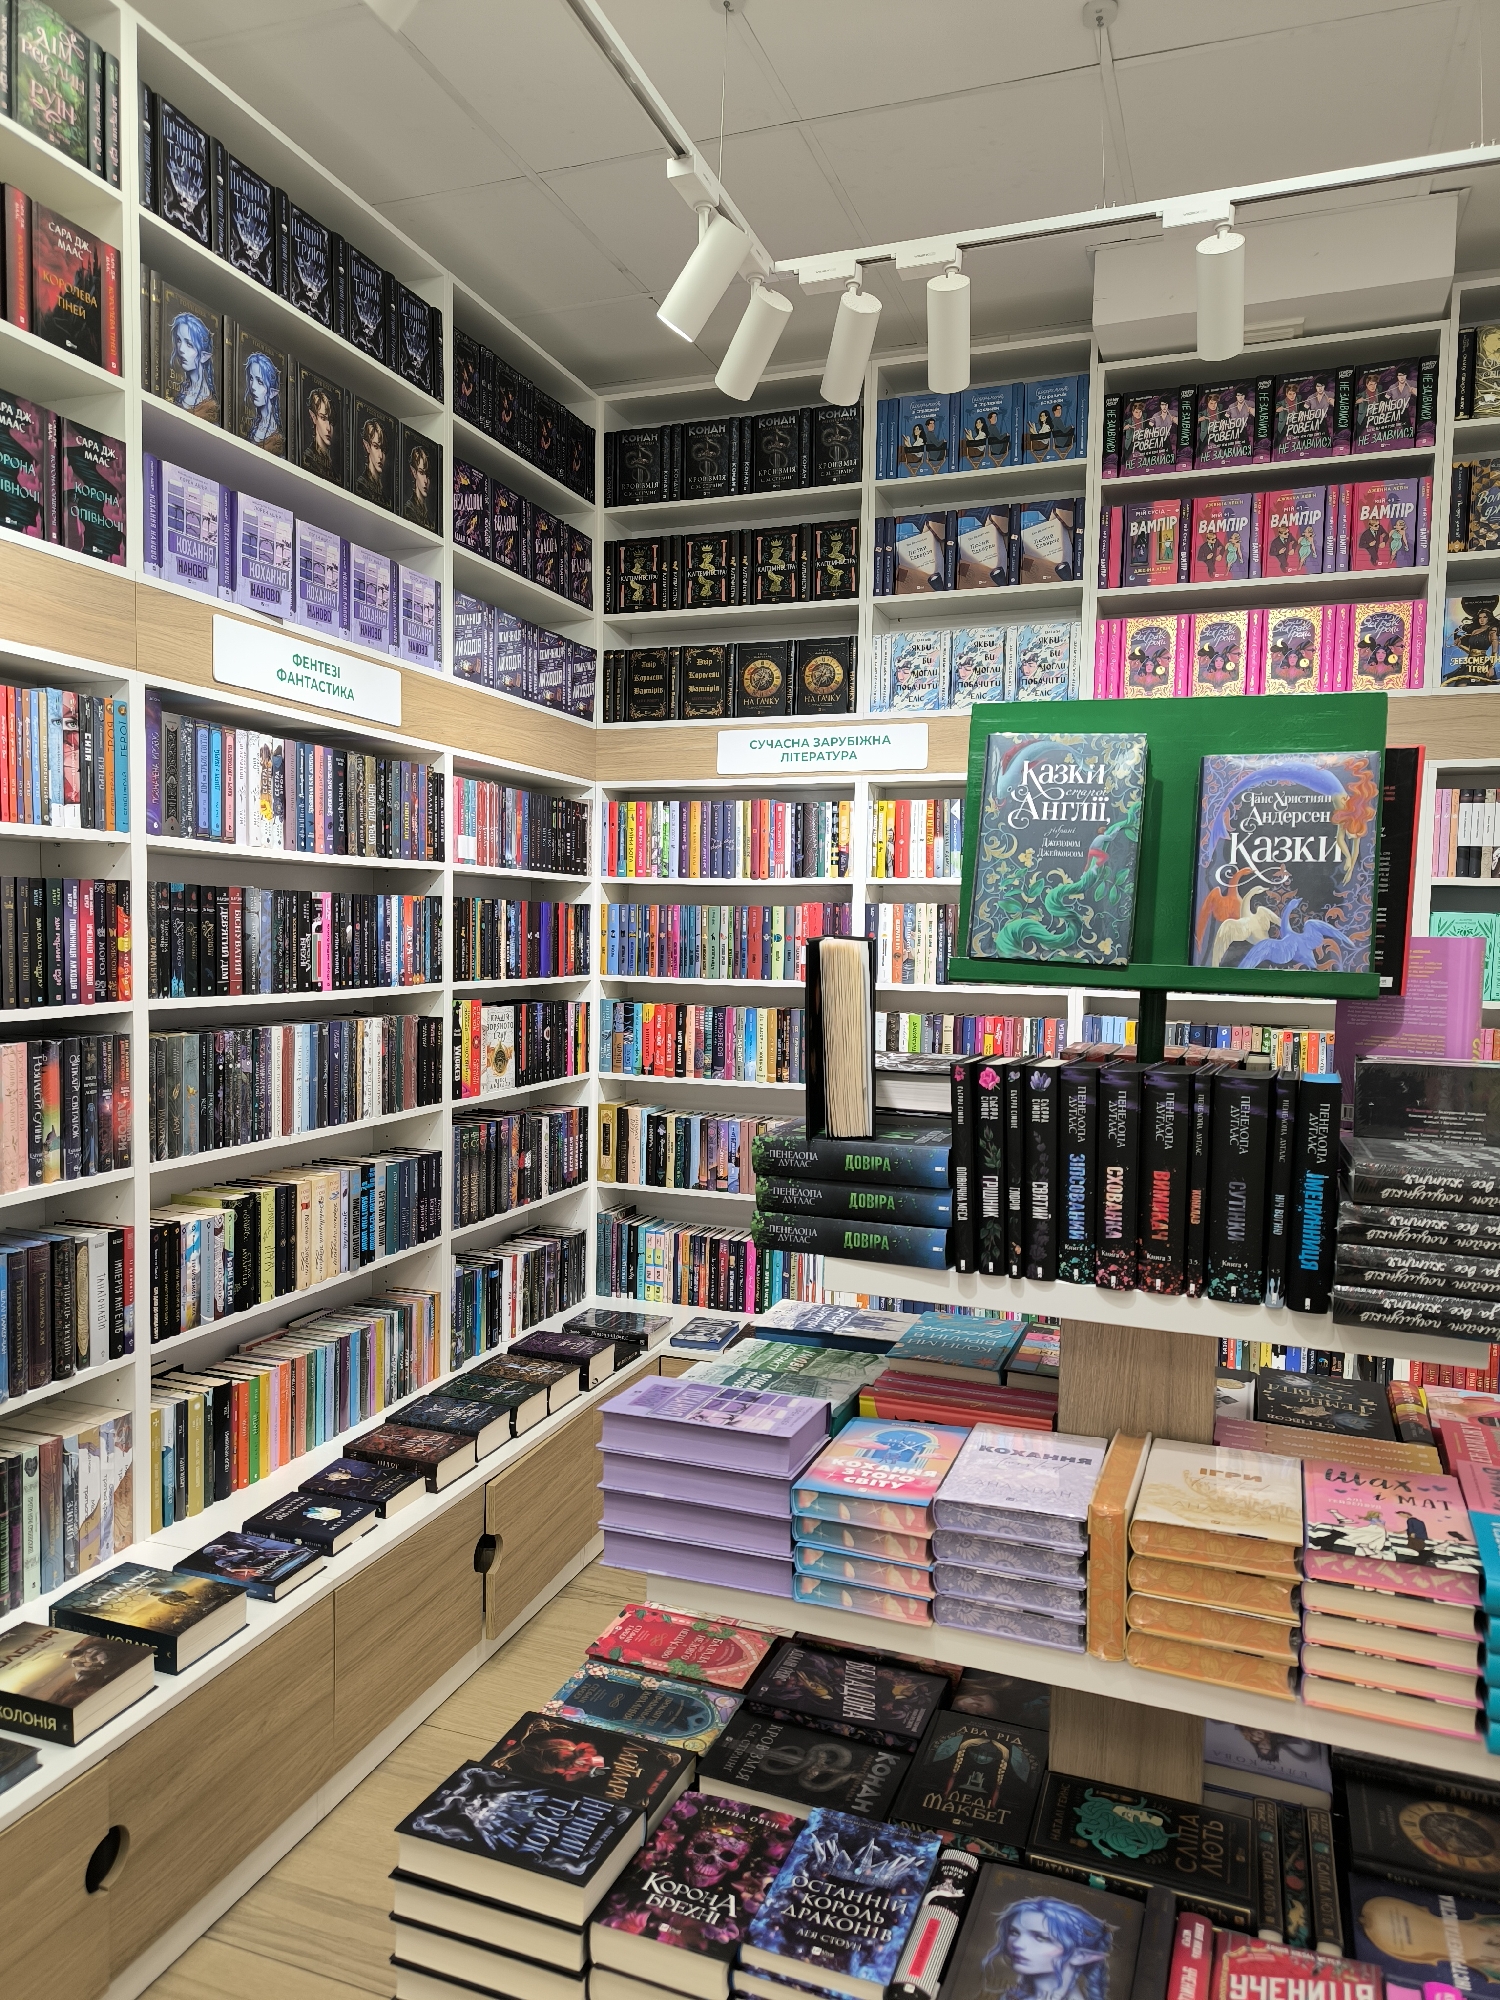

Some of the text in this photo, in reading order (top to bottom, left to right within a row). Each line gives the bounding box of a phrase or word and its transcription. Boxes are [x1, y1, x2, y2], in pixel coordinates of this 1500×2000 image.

[48, 221, 92, 254] САРА ДЖ.
[57, 238, 84, 261] МААС
[42, 270, 98, 309] КОРОЛЕВА
[57, 294, 87, 320] ТІНЕЙ
[818, 407, 858, 421] КОНАН
[1285, 406, 1329, 426] РЕЙНБОУ
[1365, 396, 1411, 417] РЕЙНБОУ
[758, 415, 796, 429] КОНАН
[1207, 415, 1249, 434] РЕЙНБОУ
[1285, 420, 1320, 436] РОВЕЛЛ
[1365, 411, 1402, 428] РОВЕЛЛ
[621, 433, 659, 445] КОНАН
[688, 424, 726, 437] КОНАН
[1132, 424, 1172, 443] РЕЙНБОУ
[1207, 430, 1241, 446] РОВЕЛЛ
[1357, 426, 1414, 447] НЕ ЗДАВАЙСЯ
[75, 435, 119, 460] САРА ДЖ.
[1132, 438, 1165, 454] РОВЕЛЛ
[1200, 445, 1252, 463] НЕ ЗДАВАЙСЯ
[1278, 436, 1333, 455] НЕ ЗДАВАЙСЯ
[84, 450, 111, 468] МААС
[1125, 453, 1176, 470] НЕ ЗДАВАЙСЯ
[74, 481, 120, 508] КОРОНА
[70, 505, 124, 533] ОПІВНОЧІ
[1135, 509, 1147, 517] МІЙ
[1270, 510, 1323, 528] ВАМПІР
[1359, 502, 1415, 521] ВАМПІР
[1129, 515, 1178, 537] ВАМПІР
[1198, 516, 1249, 534] ВАМПІР
[176, 535, 215, 565] КОХАННЯ
[177, 558, 209, 582] НАНОВО
[249, 560, 288, 589] КОХАННЯ
[249, 581, 281, 605] НАНОВО
[911, 644, 933, 652] ЯКБИ
[973, 640, 996, 649] ЯКБИ
[1038, 636, 1061, 645] ЯКБИ
[291, 653, 342, 680] ФЕНТЕЗІ
[911, 669, 939, 678] МОГЛИ
[973, 665, 1001, 675] МОГЛИ
[1038, 662, 1067, 671] МОГЛИ
[276, 667, 355, 702] ФАНТАСТИКА
[896, 683, 939, 692] ПОБАЧИТИ
[956, 679, 1001, 689] ПОБАЧИТИ
[1021, 675, 1067, 686] ПОБАЧИТИ
[743, 695, 781, 706] НА ГАЧКУ
[804, 693, 842, 703] НА ГАЧКУ
[908, 694, 926, 703] ЕЛІС
[969, 692, 988, 701] ЕЛІС
[1033, 689, 1053, 698] ЕЛІС
[83, 732, 93, 763] СИЛА
[749, 734, 892, 750] СУЧАСНА ЗАРУБІЖНА
[780, 750, 858, 763] ЛІТЕРАТУРА
[1021, 760, 1106, 795] Казки
[1065, 786, 1109, 803] старої
[1007, 791, 1111, 829] Англії,
[1240, 806, 1332, 834] Андерсен
[1220, 832, 1344, 882] Казки
[69, 918, 79, 990] ПОМІЧНИЦЯ ЛИХОДІЯ
[98, 941, 107, 977] МОРОЗ
[1031, 1098, 1041, 1123] СІМОНЕ
[1229, 1105, 1240, 1147] ДУГЛАС
[1238, 1095, 1250, 1155] ПЕНЕЛОПА
[1307, 1113, 1319, 1155] ДУГЛАС
[1316, 1103, 1331, 1164] ПЕНЕЛОПА
[769, 1149, 819, 1162] ПЕНЕЛОПА
[778, 1158, 812, 1168] ДУГЛАС
[844, 1154, 892, 1172] ДОВІРА
[1402, 1173, 1465, 1189] життя
[772, 1186, 823, 1199] ПЕНЕЛОПА
[782, 1195, 816, 1206] ДУГЛАС
[849, 1192, 896, 1211] ДОВІРА
[982, 1175, 999, 1218] ГРІШНИК
[1008, 1186, 1021, 1211] ГЛОРІЯ
[1031, 1181, 1052, 1220] СВЯТИЙ
[1068, 1153, 1088, 1241] ЗІПСОВАНИЙ
[957, 1198, 969, 1221] МЕСА
[1105, 1166, 1124, 1239] СХОВАНКА
[1151, 1170, 1171, 1241] ВИМИКАЧ
[1190, 1189, 1202, 1225] КОНКЛАВ
[1227, 1181, 1247, 1242] СУТІНКИ
[1299, 1170, 1330, 1271] ІМЕНИННИЦЯ
[1387, 1215, 1450, 1231] життя
[768, 1224, 818, 1238] ПЕНЕЛОПА
[777, 1233, 811, 1244] ДУГЛАС
[1365, 1227, 1449, 1246] поцілунків
[843, 1231, 890, 1251] ДОВІРА
[1064, 1243, 1083, 1251] Книга
[1101, 1250, 1119, 1258] Книга
[1146, 1253, 1172, 1262] Книга 3
[1221, 1259, 1248, 1269] Книга 4
[1385, 1256, 1447, 1273] життя
[1362, 1268, 1447, 1287] поцілунків
[1381, 1297, 1473, 1320] все життя
[1359, 1310, 1442, 1329] поцілунків
[930, 1332, 997, 1346] ВІРИЛИ
[941, 1342, 993, 1353] КОЛИ
[1266, 1383, 1343, 1401] ОСВІТА
[1297, 1398, 1368, 1416] ТЕМНА
[978, 1444, 1093, 1466] КОХАННЯ
[831, 1457, 938, 1479] КОХАННЯ
[841, 1466, 916, 1484] З ТОГО
[1199, 1467, 1264, 1483] ІГРИ
[843, 1475, 905, 1490] СВІТУ
[842, 1659, 876, 1721] БЕЛАДОНА
[0, 1704, 58, 1732] КОЛОНІЯ
[956, 1725, 1023, 1745] АВА РІД
[735, 1723, 785, 1782] КРОВ ЗМІЯ
[850, 1751, 901, 1814] КОНАН
[921, 1791, 1012, 1826] МАКБЕТ
[947, 1790, 993, 1809] ЛЕДІ
[1051, 1782, 1071, 1842] НАТАЛІ ГЕЙНС
[523, 1797, 582, 1853] ТРУНОК
[551, 1796, 615, 1860] НІЧНИЙ
[749, 1814, 781, 1830] ОВЕН
[1174, 1813, 1201, 1874] СЛІПА
[1198, 1818, 1226, 1878] ЛЮТЬ
[642, 1871, 739, 1921] КОРОНА
[791, 1873, 909, 1916] ОСТАННІЙ
[645, 1892, 722, 1927] БРЕХНІ
[801, 1892, 887, 1926] КОРОЛЬ
[780, 1902, 894, 1944] ДРАКОНІВ
[796, 1926, 863, 1953] ЛЕЯ СТОУН
[1229, 1973, 1376, 2000] УЧЕНИЦЯ
